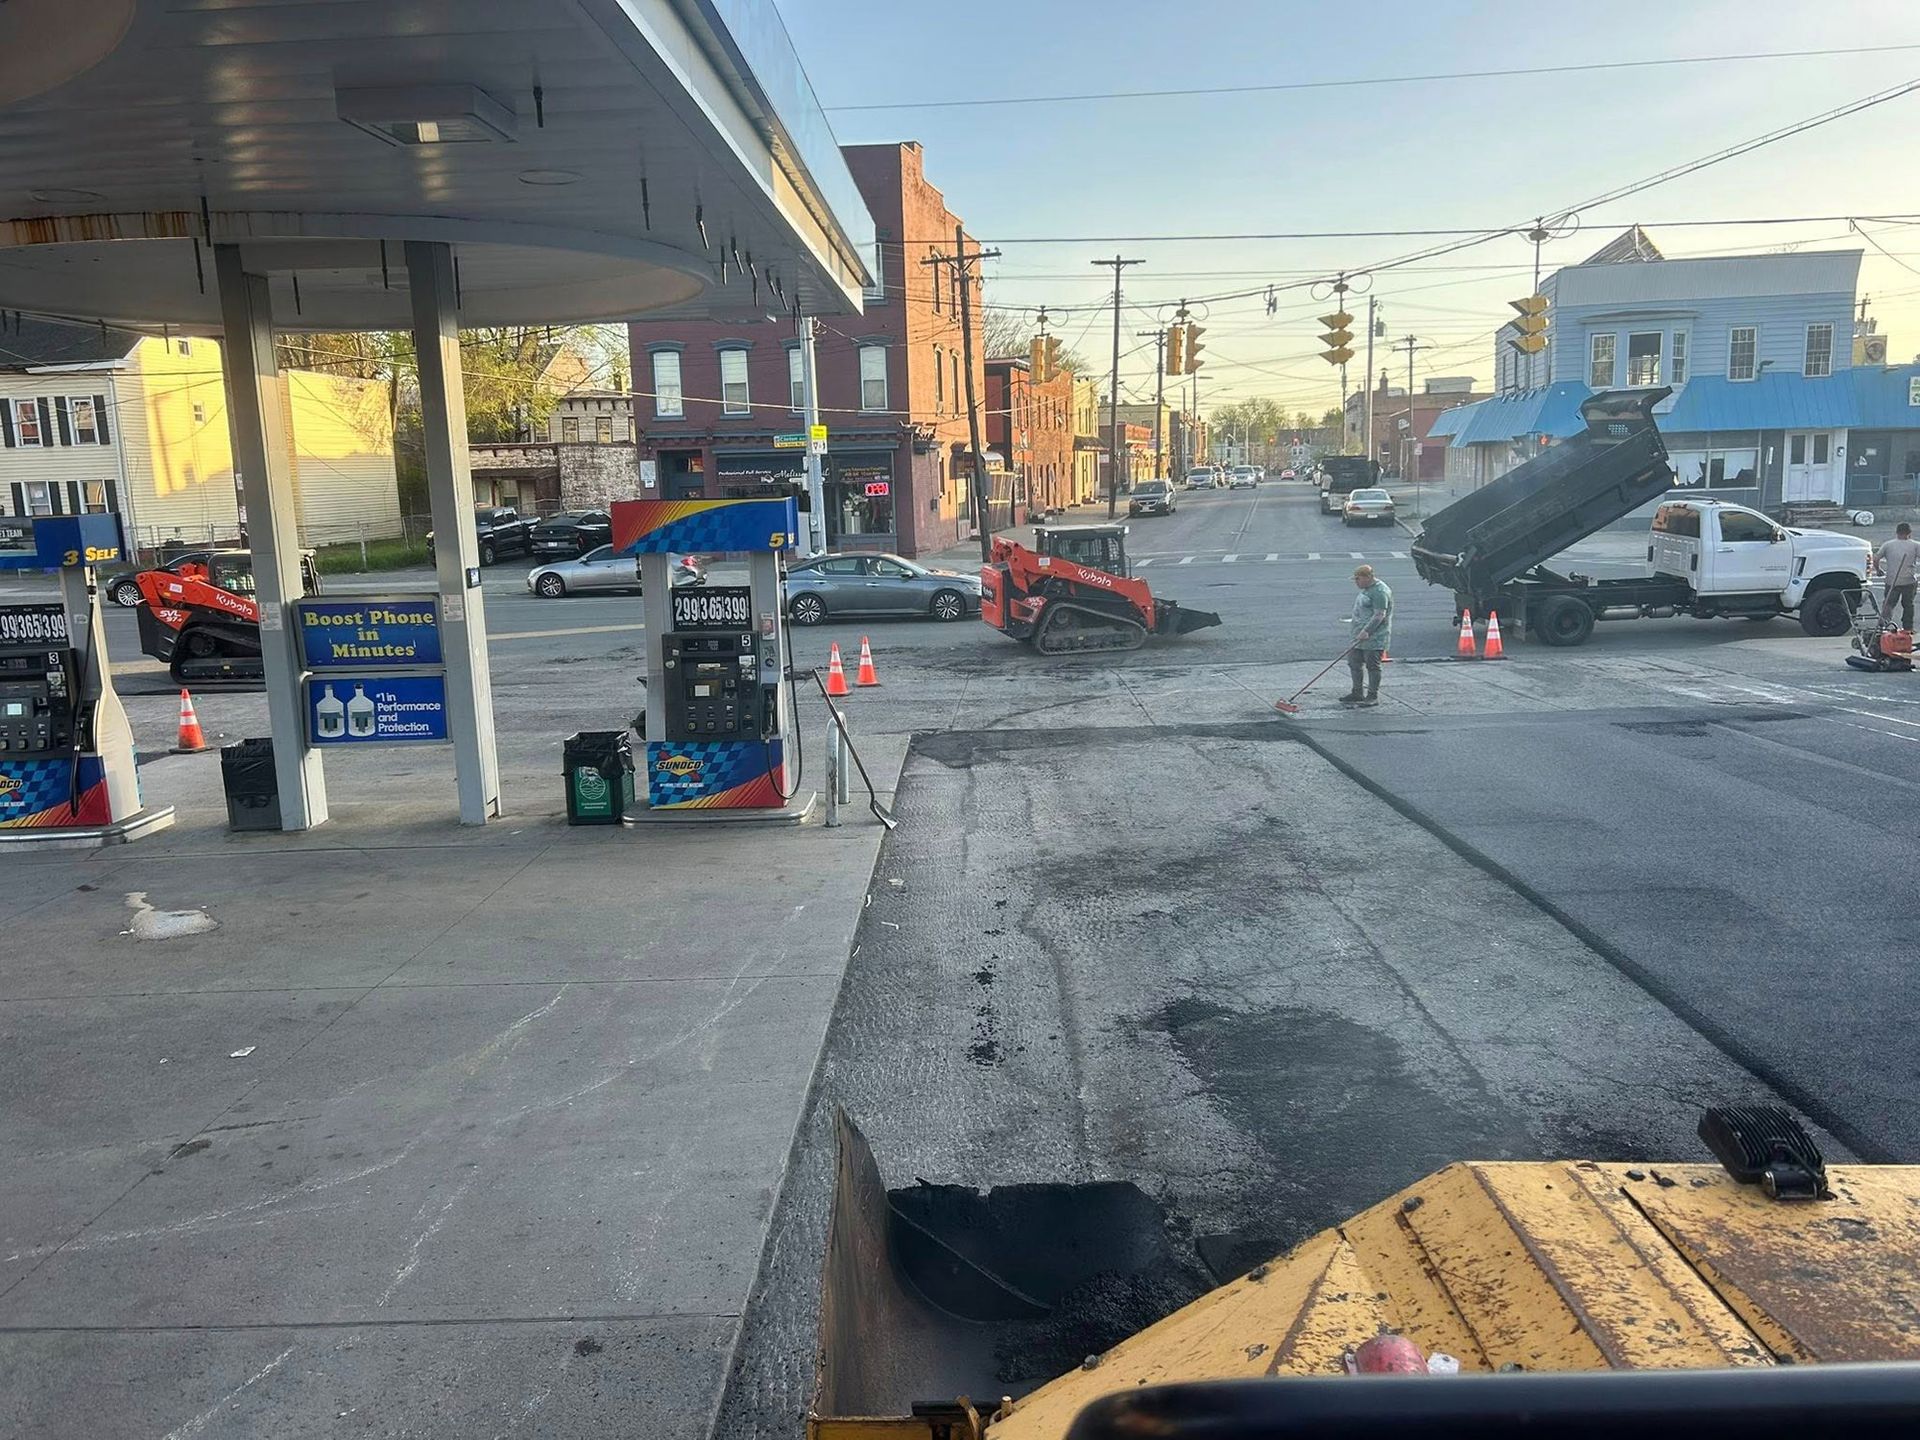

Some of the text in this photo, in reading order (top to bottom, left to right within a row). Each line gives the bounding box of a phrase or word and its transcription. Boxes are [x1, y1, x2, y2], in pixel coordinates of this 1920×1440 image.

[768, 532, 785, 548] 5
[63, 550, 79, 566] 3
[1077, 567, 1112, 587] Kubota
[216, 593, 253, 616] Kubota
[674, 597, 698, 621] 299
[701, 596, 723, 620] 365
[724, 596, 747, 620] 399
[18, 614, 42, 638] 365
[42, 614, 66, 638] 399
[303, 610, 434, 626] Boost Phone
[0, 614, 18, 639] 99
[357, 628, 380, 641] in
[332, 643, 415, 658] Minutes
[386, 692, 397, 701] in
[377, 702, 441, 712] Performance
[378, 712, 398, 722] and
[378, 722, 430, 732] Protection
[658, 760, 702, 770] SUNOCO
[0, 780, 21, 788] OCO
